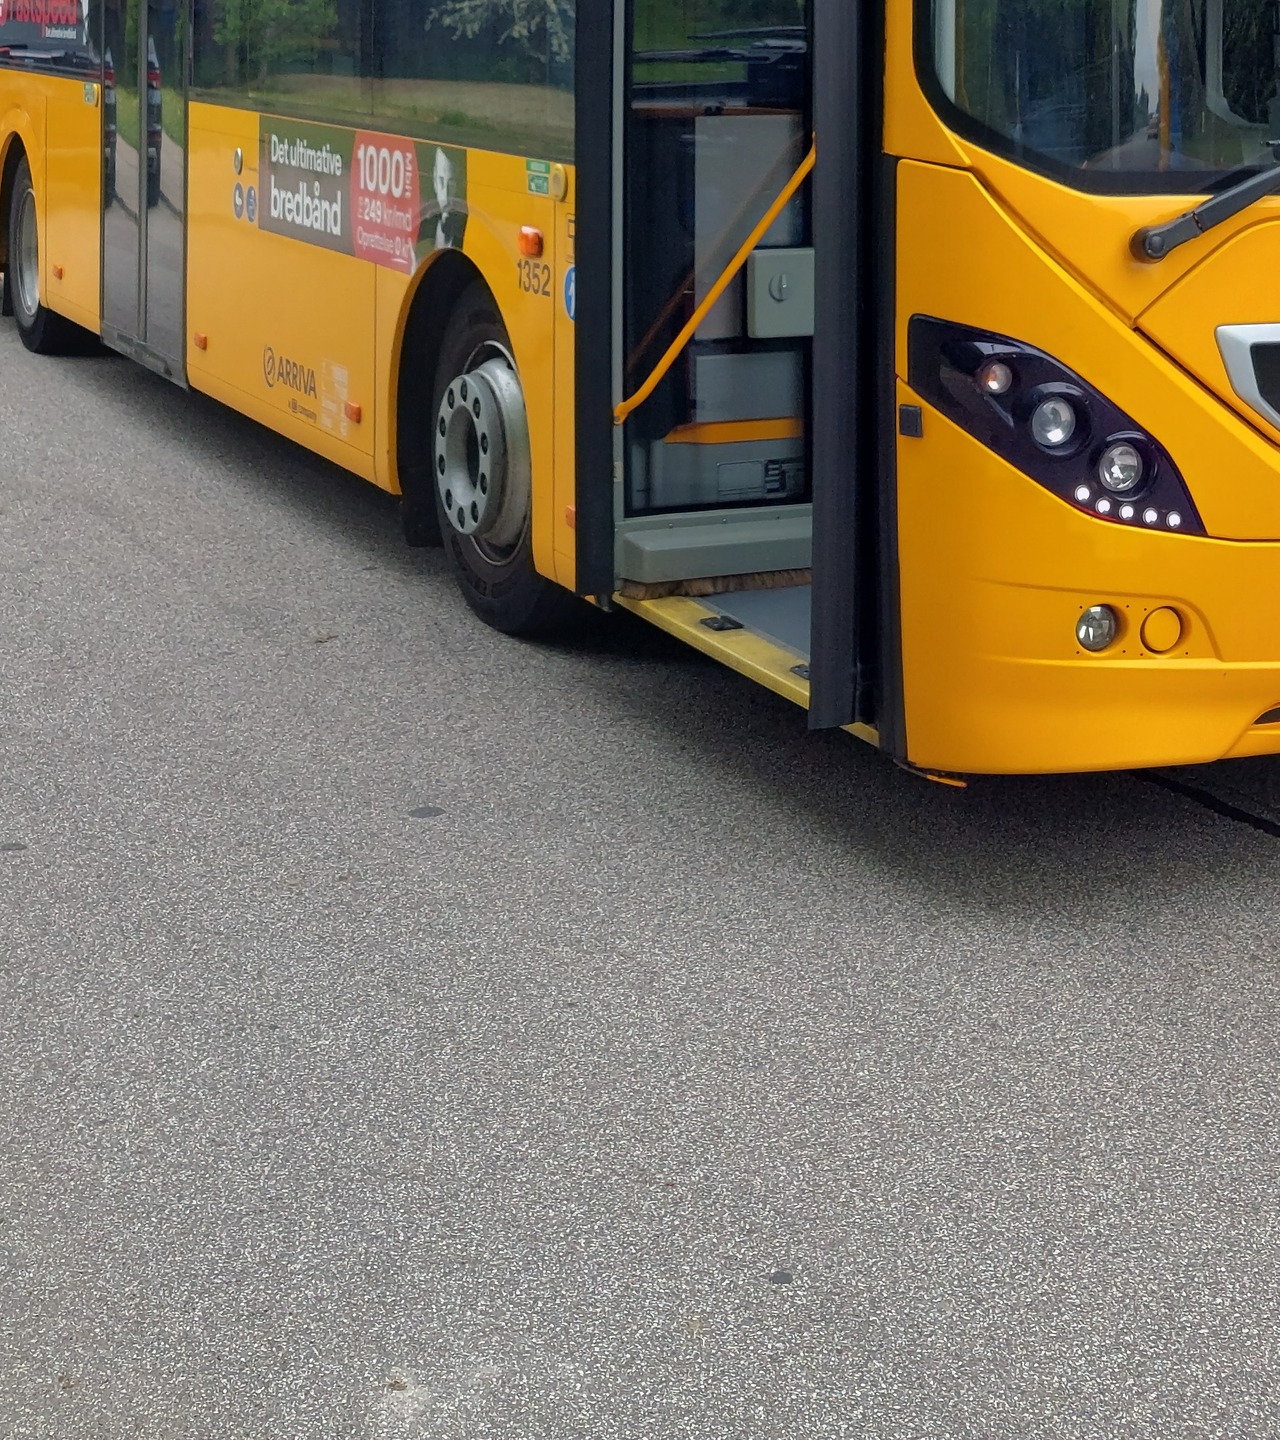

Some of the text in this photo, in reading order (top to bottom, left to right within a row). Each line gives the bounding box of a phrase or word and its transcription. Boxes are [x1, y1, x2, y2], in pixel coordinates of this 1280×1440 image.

[271, 134, 342, 177] Det ultimative
[357, 143, 405, 199] 1000
[271, 174, 342, 237] bredbånd
[363, 197, 382, 224] 249
[517, 258, 551, 298] 1352
[277, 356, 318, 400] ARRIVA
